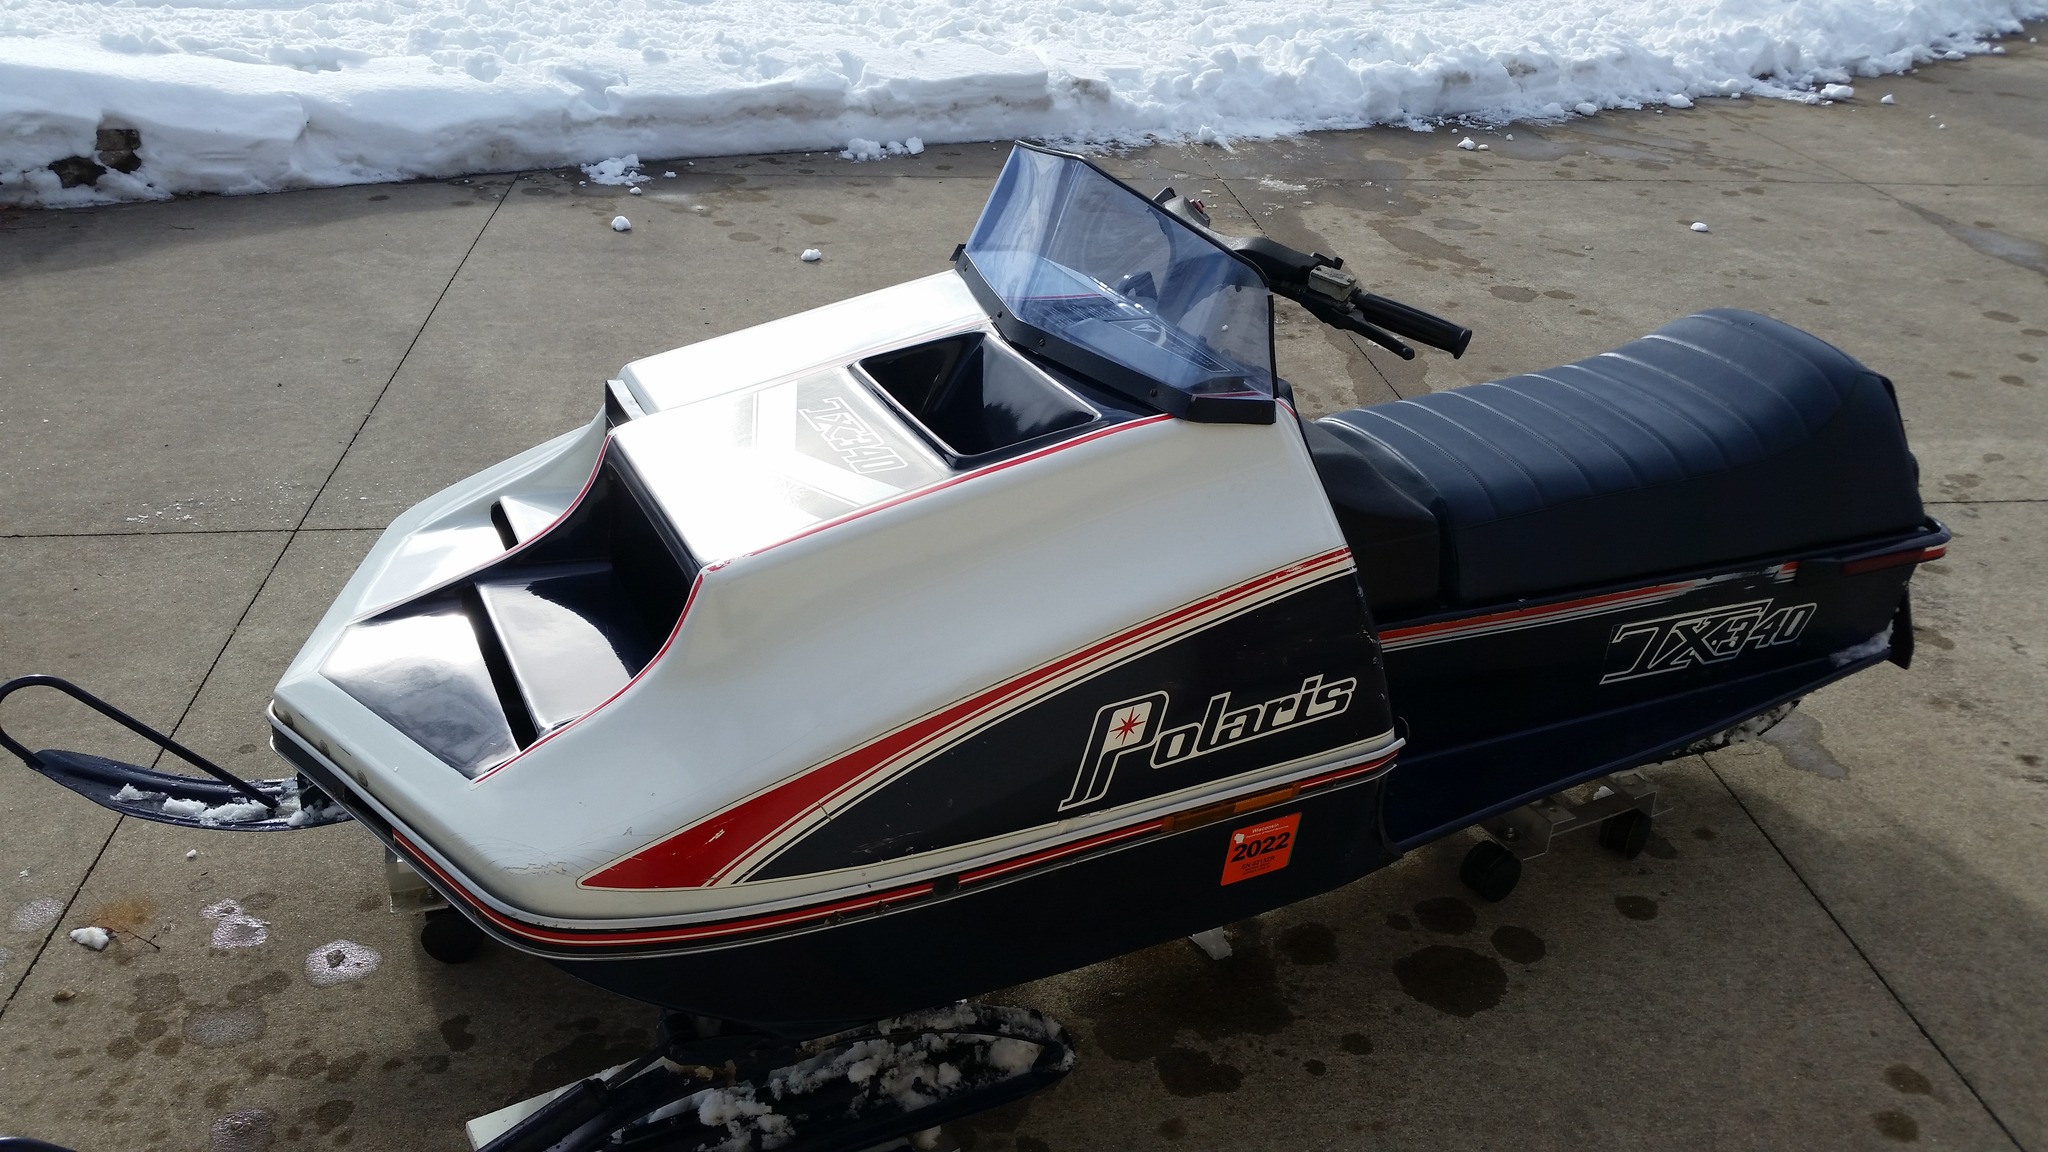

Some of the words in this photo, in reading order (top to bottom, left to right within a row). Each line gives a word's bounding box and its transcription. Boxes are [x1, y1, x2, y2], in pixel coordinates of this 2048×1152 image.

[798, 396, 908, 474] TX340
[1599, 598, 1817, 685] TX340
[1057, 674, 1357, 812] Polaris
[1230, 832, 1291, 863] 2022
[1252, 823, 1280, 834] Wisconsin
